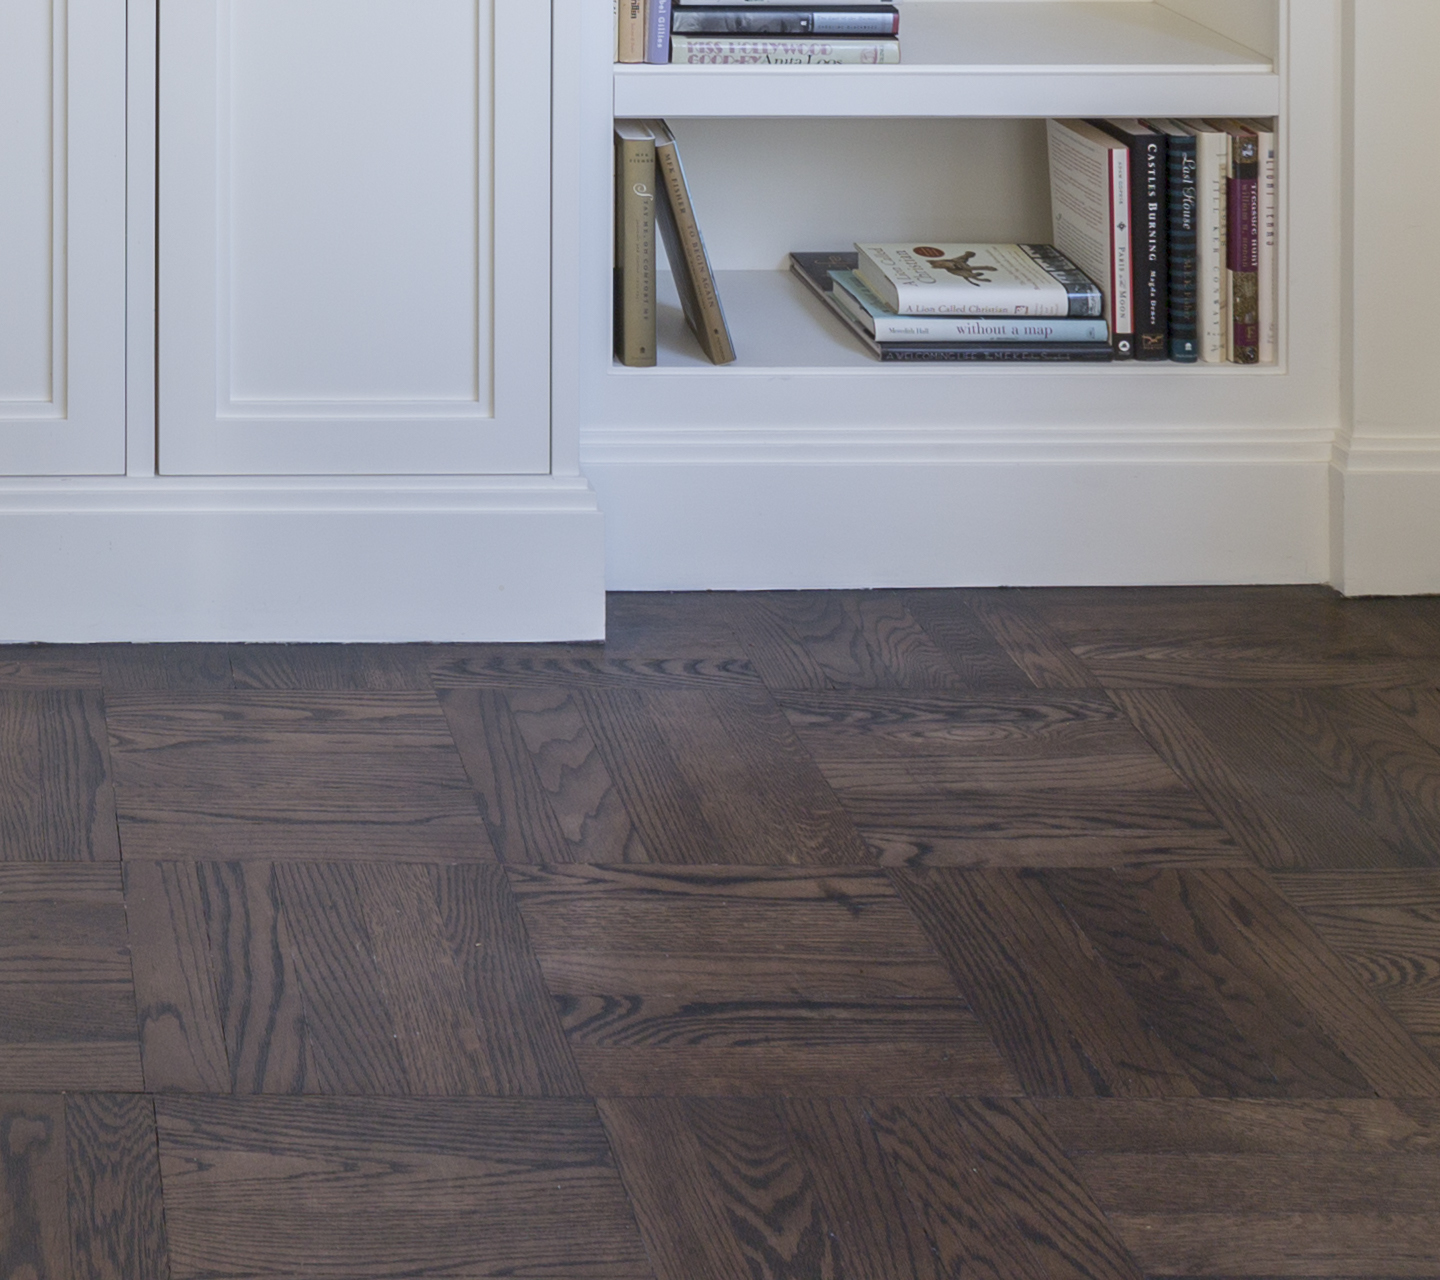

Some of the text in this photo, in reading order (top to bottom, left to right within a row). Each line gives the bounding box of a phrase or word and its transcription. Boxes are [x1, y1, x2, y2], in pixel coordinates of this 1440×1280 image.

[1147, 143, 1157, 261] CASTLES BURNING
[956, 323, 1007, 337] without
